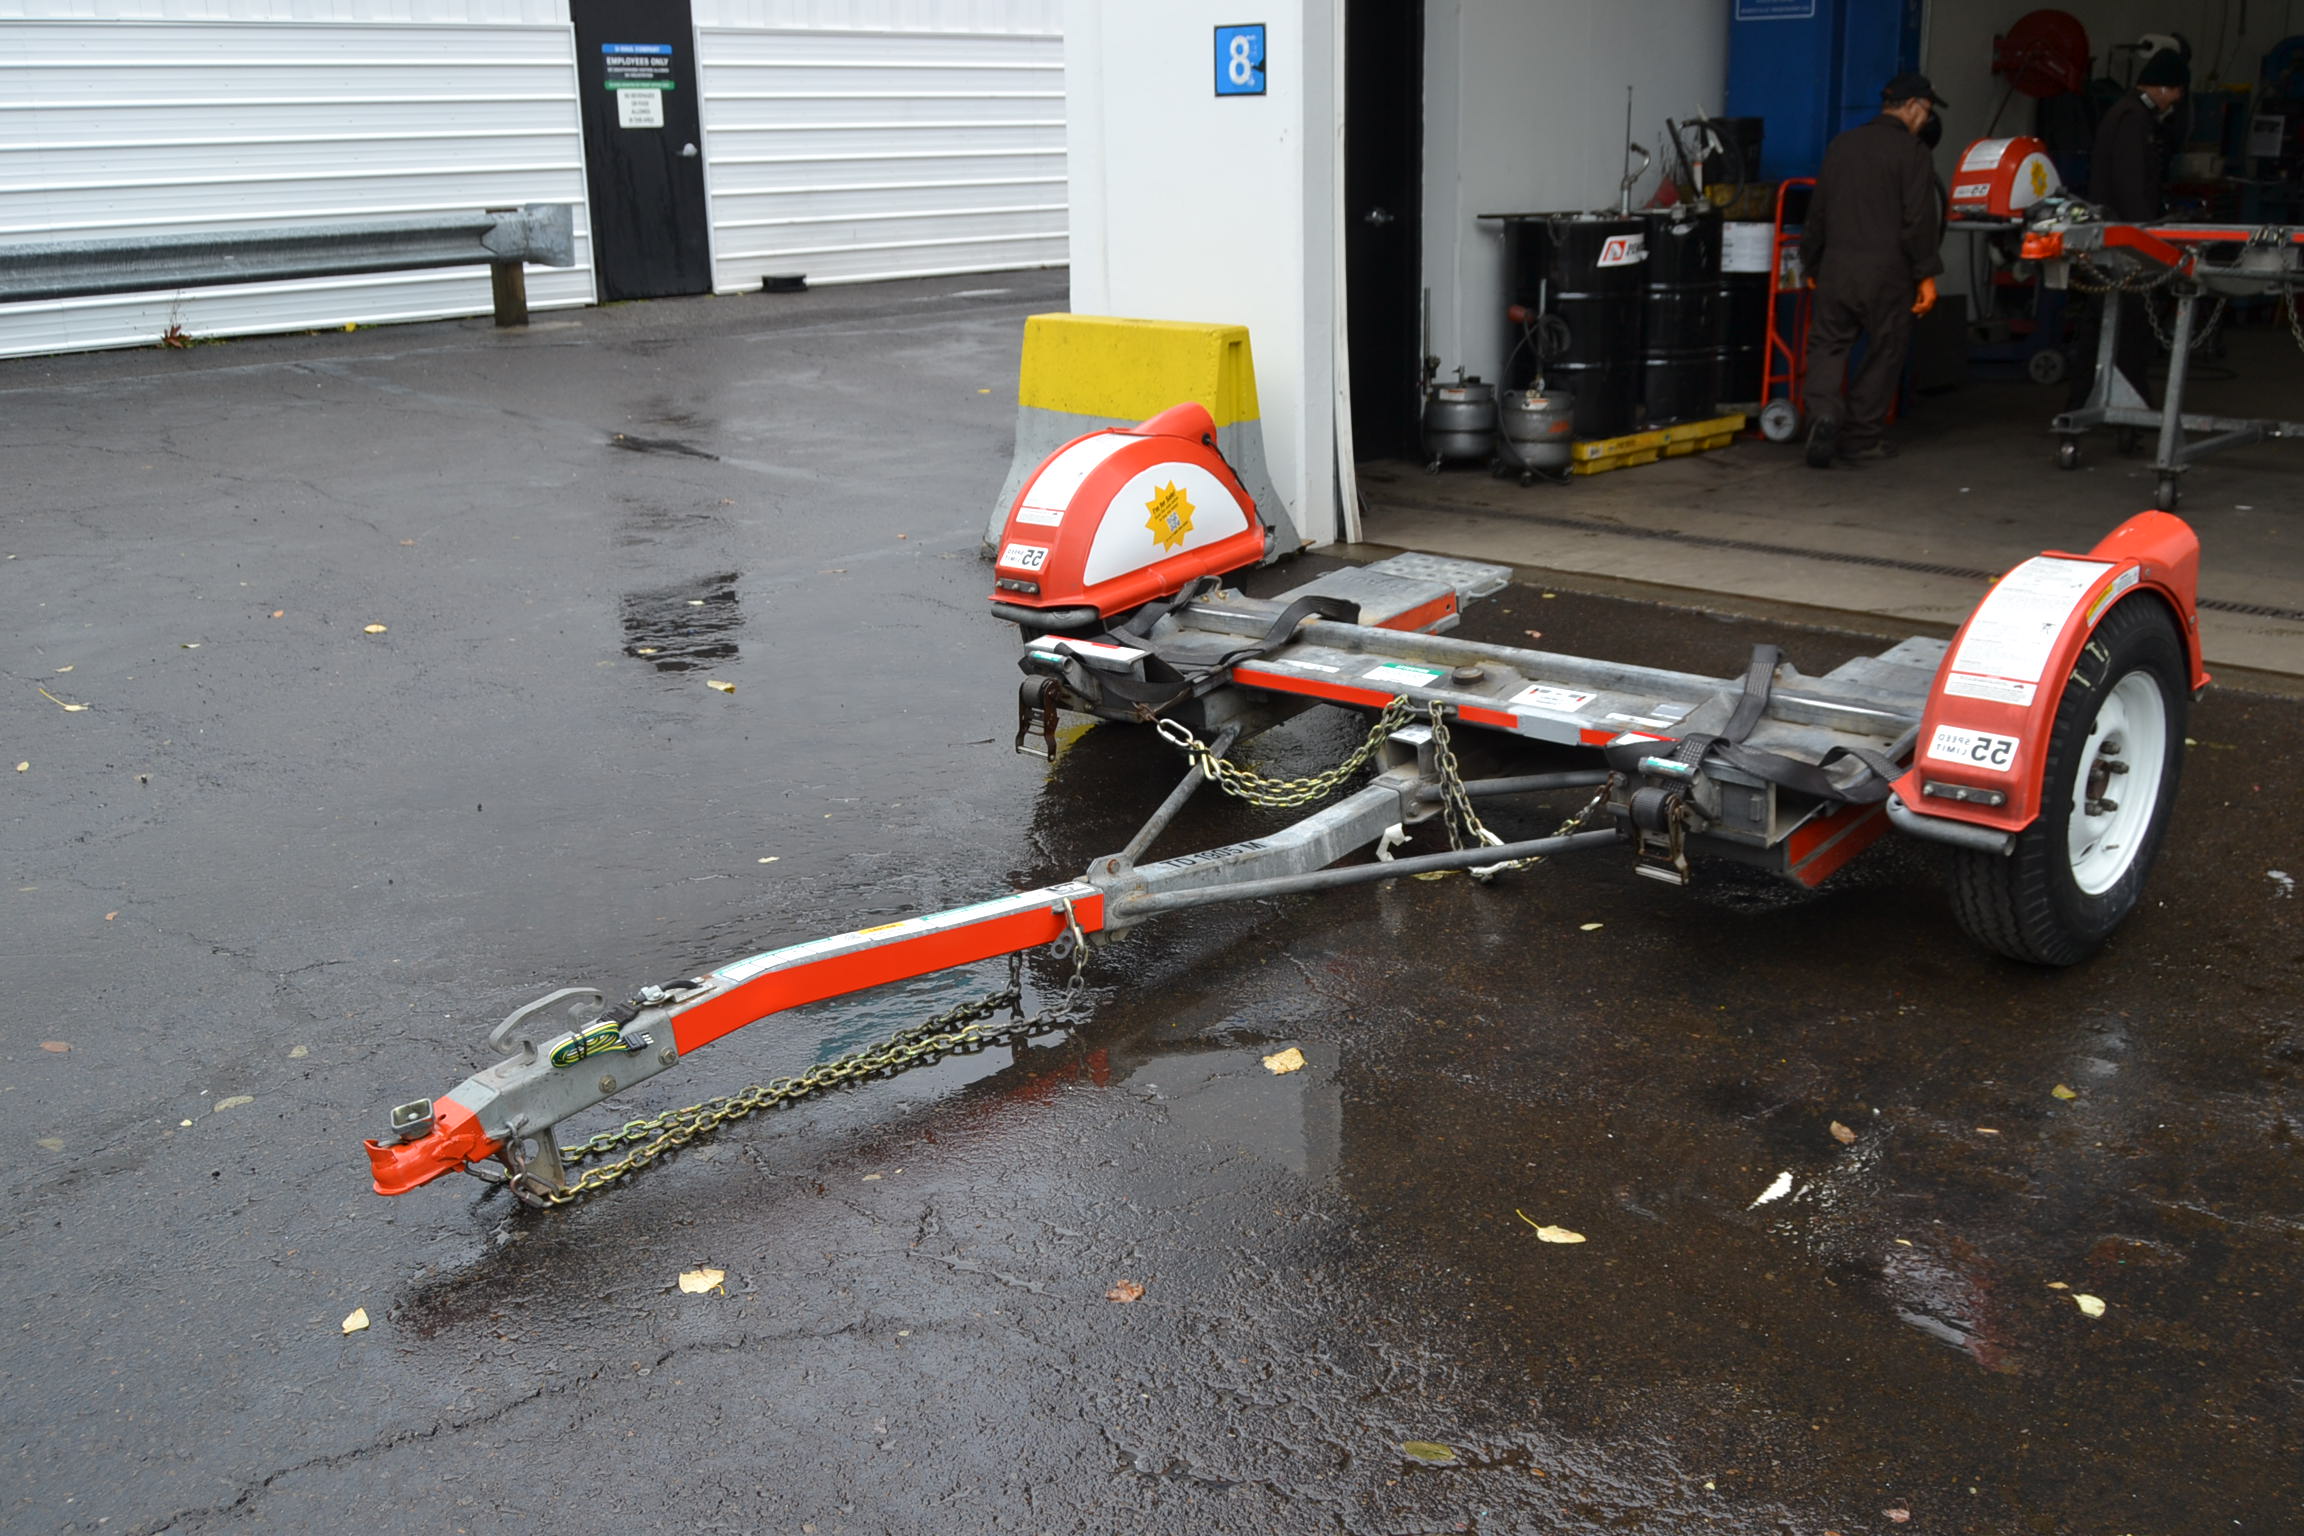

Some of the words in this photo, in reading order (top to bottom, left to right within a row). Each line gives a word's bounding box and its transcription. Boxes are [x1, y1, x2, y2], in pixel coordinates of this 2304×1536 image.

[606, 56, 650, 66] EMPLOYEES
[650, 57, 669, 66] ONLY
[1228, 34, 1251, 86] 8
